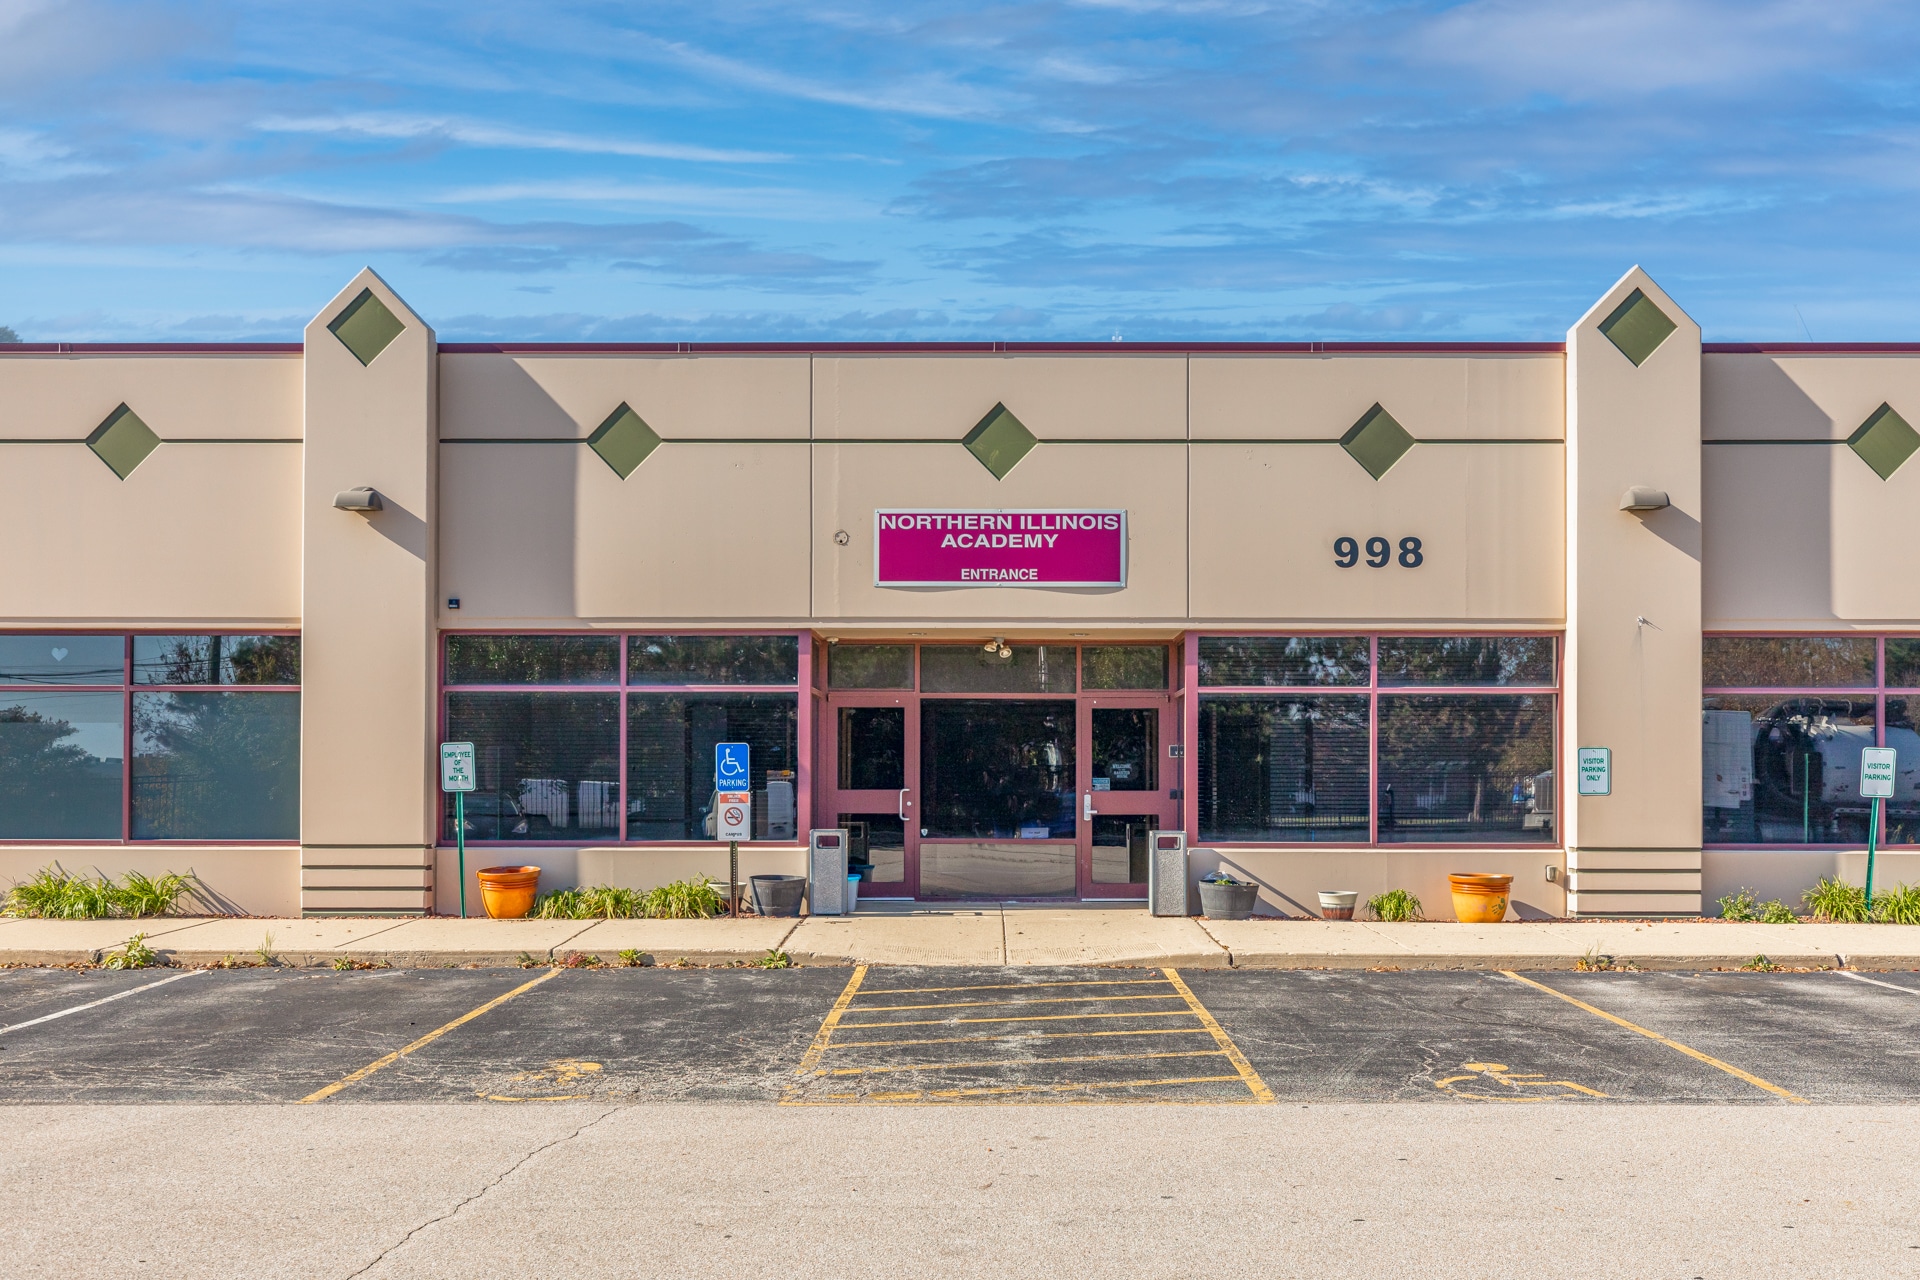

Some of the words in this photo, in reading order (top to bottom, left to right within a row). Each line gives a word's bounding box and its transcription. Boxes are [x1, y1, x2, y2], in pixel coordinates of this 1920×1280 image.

[881, 515, 1012, 530] NORTHERN
[1020, 515, 1119, 530] ILLINOIS
[940, 533, 1059, 549] ACADEMY
[1333, 536, 1424, 568] 998
[961, 568, 1038, 580] ENTRANCE
[719, 779, 747, 787] PARKING
[1865, 773, 1892, 781] PARKING
